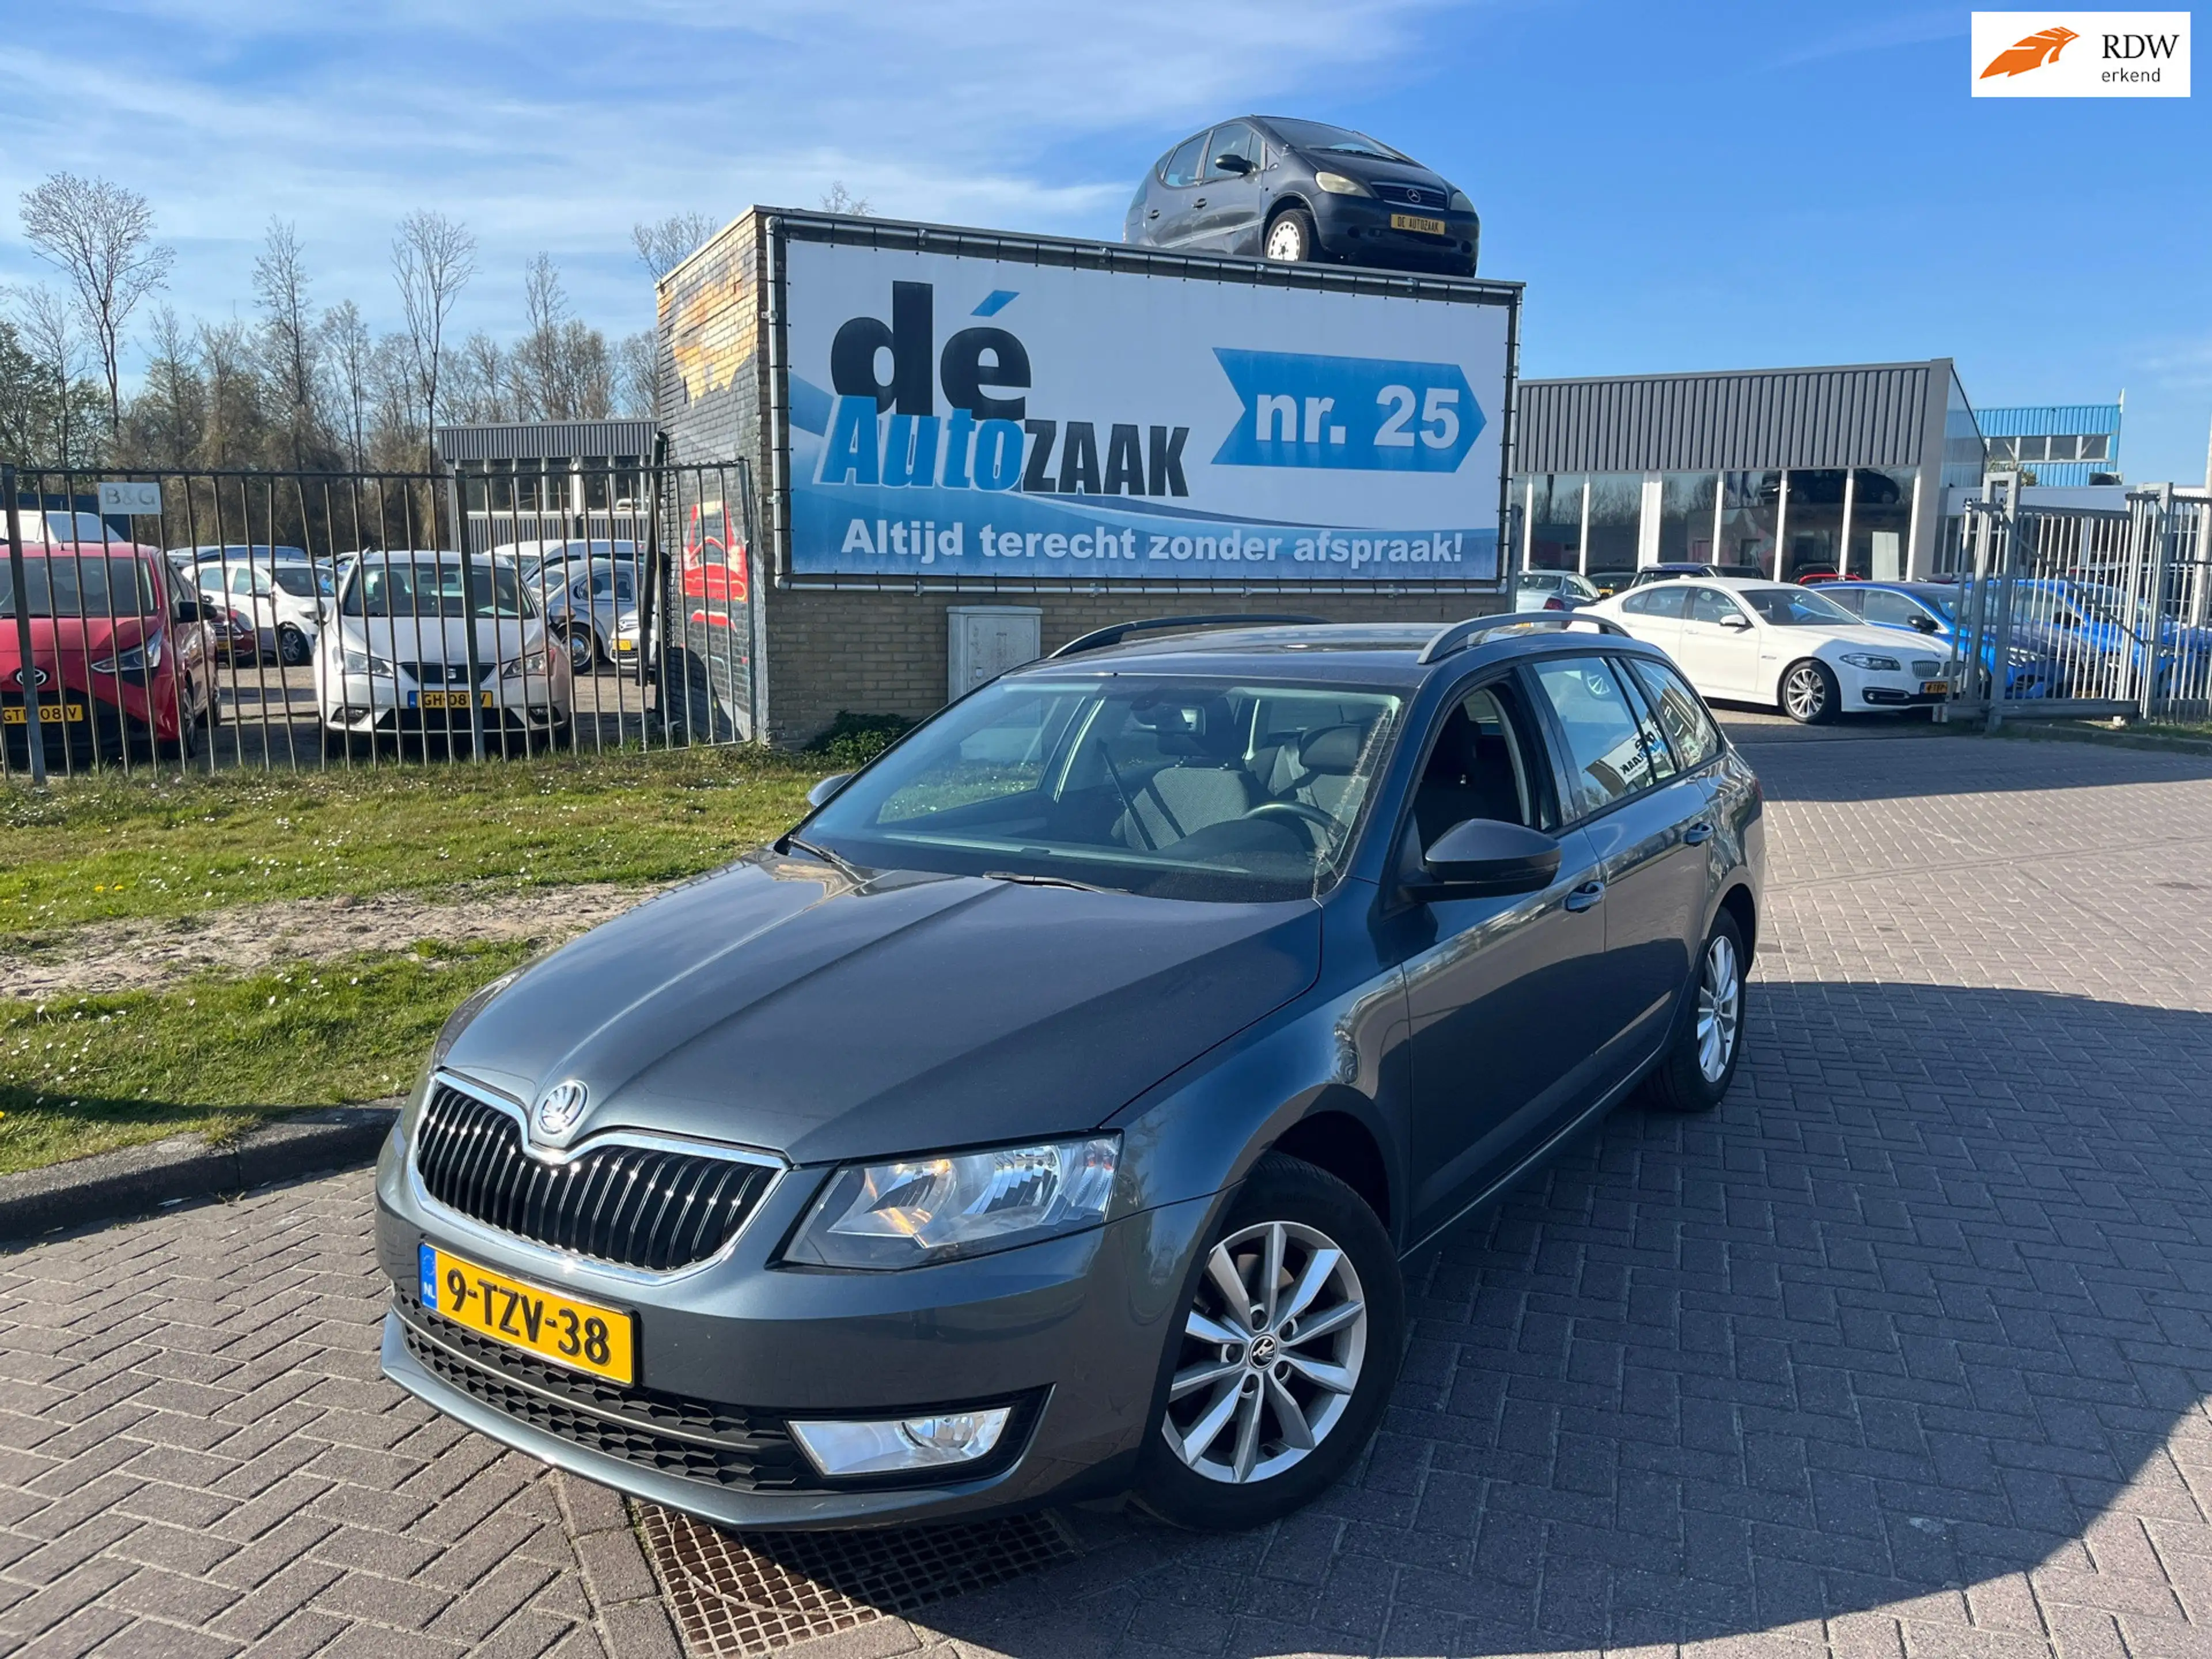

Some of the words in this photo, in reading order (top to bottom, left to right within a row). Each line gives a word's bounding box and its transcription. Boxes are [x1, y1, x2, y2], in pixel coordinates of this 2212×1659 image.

[831, 280, 1032, 422] dé
[1255, 393, 1346, 445] nr.
[1373, 384, 1460, 449] 25
[840, 518, 964, 564] Altijd
[979, 523, 1136, 560] terecht
[1149, 529, 1282, 562] zonder
[1293, 531, 1462, 569] afspraak!
[423, 1282, 436, 1299] NL
[447, 1267, 611, 1366] 9-TZV-38
